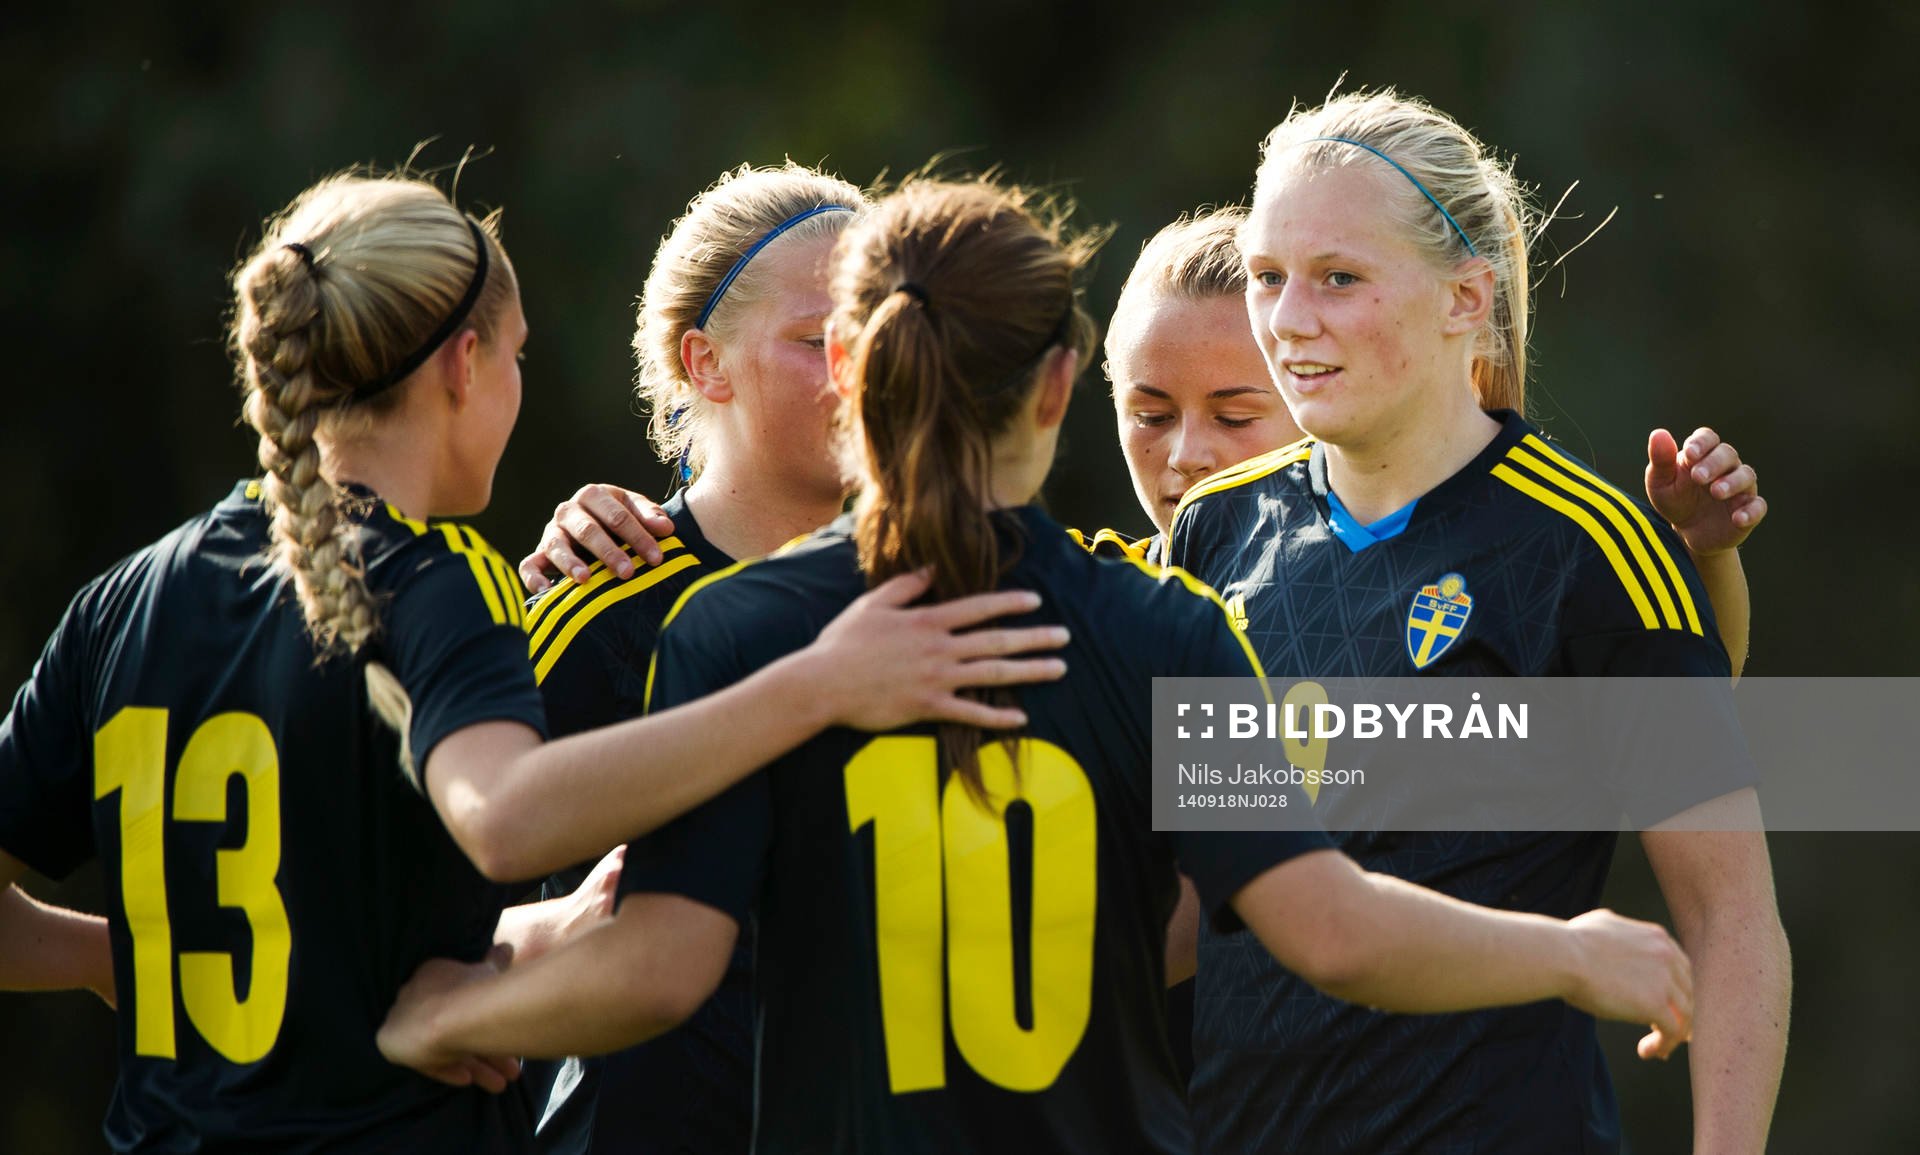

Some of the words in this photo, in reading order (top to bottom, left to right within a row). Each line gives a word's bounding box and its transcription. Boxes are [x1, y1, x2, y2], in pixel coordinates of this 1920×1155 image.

[94, 706, 292, 1064] 13
[843, 735, 1097, 1094] 10
[1279, 681, 1329, 808] 9
